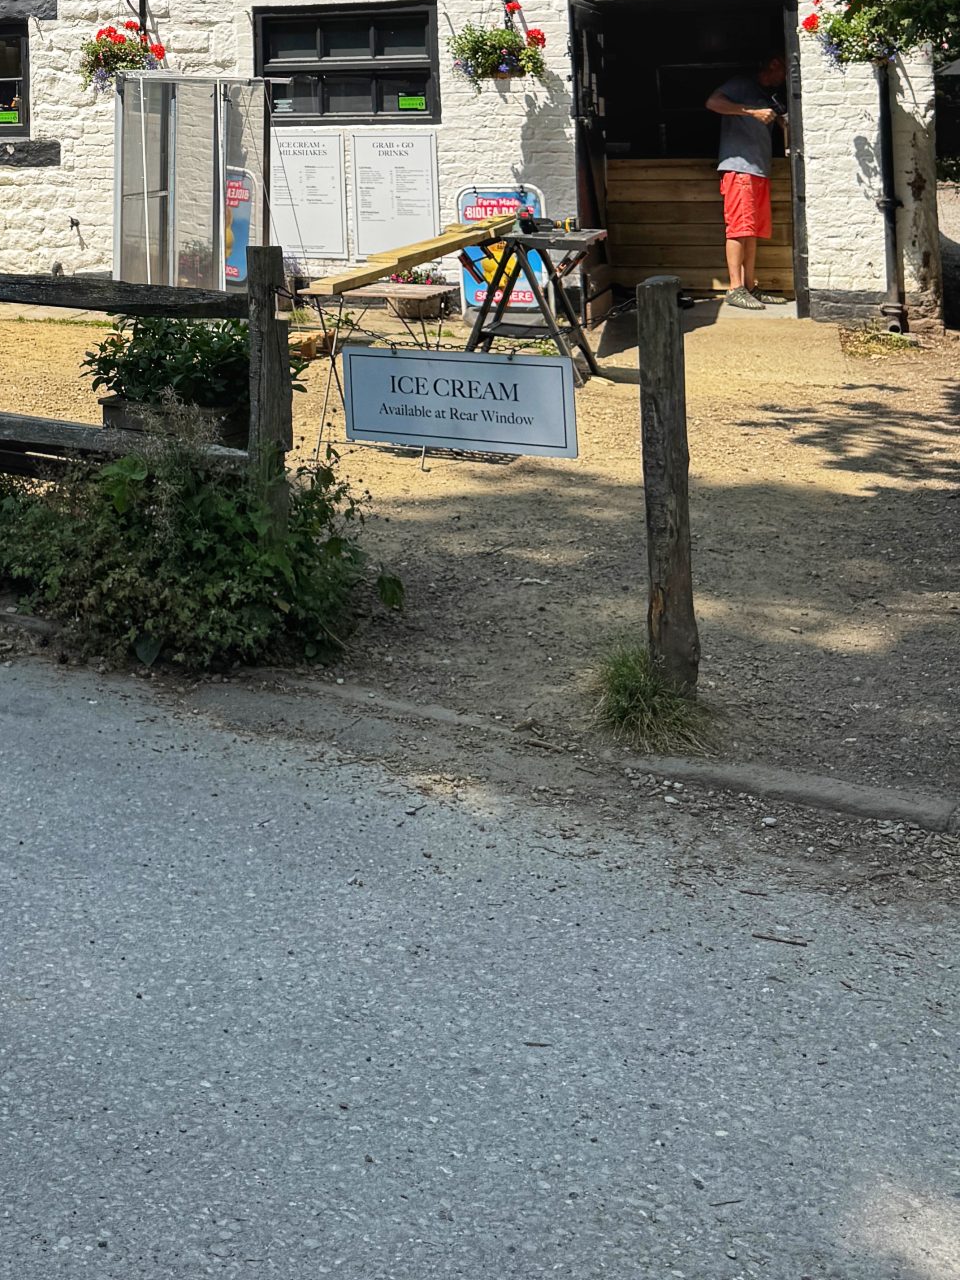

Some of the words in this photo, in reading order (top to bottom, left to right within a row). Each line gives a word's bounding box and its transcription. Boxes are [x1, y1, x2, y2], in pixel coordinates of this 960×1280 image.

[478, 198, 497, 206] Farm
[390, 375, 429, 396] ICE
[433, 378, 520, 402] CREAM
[379, 403, 432, 418] Available
[435, 409, 446, 419] at
[450, 407, 478, 422] Rear
[481, 410, 534, 426] Window
